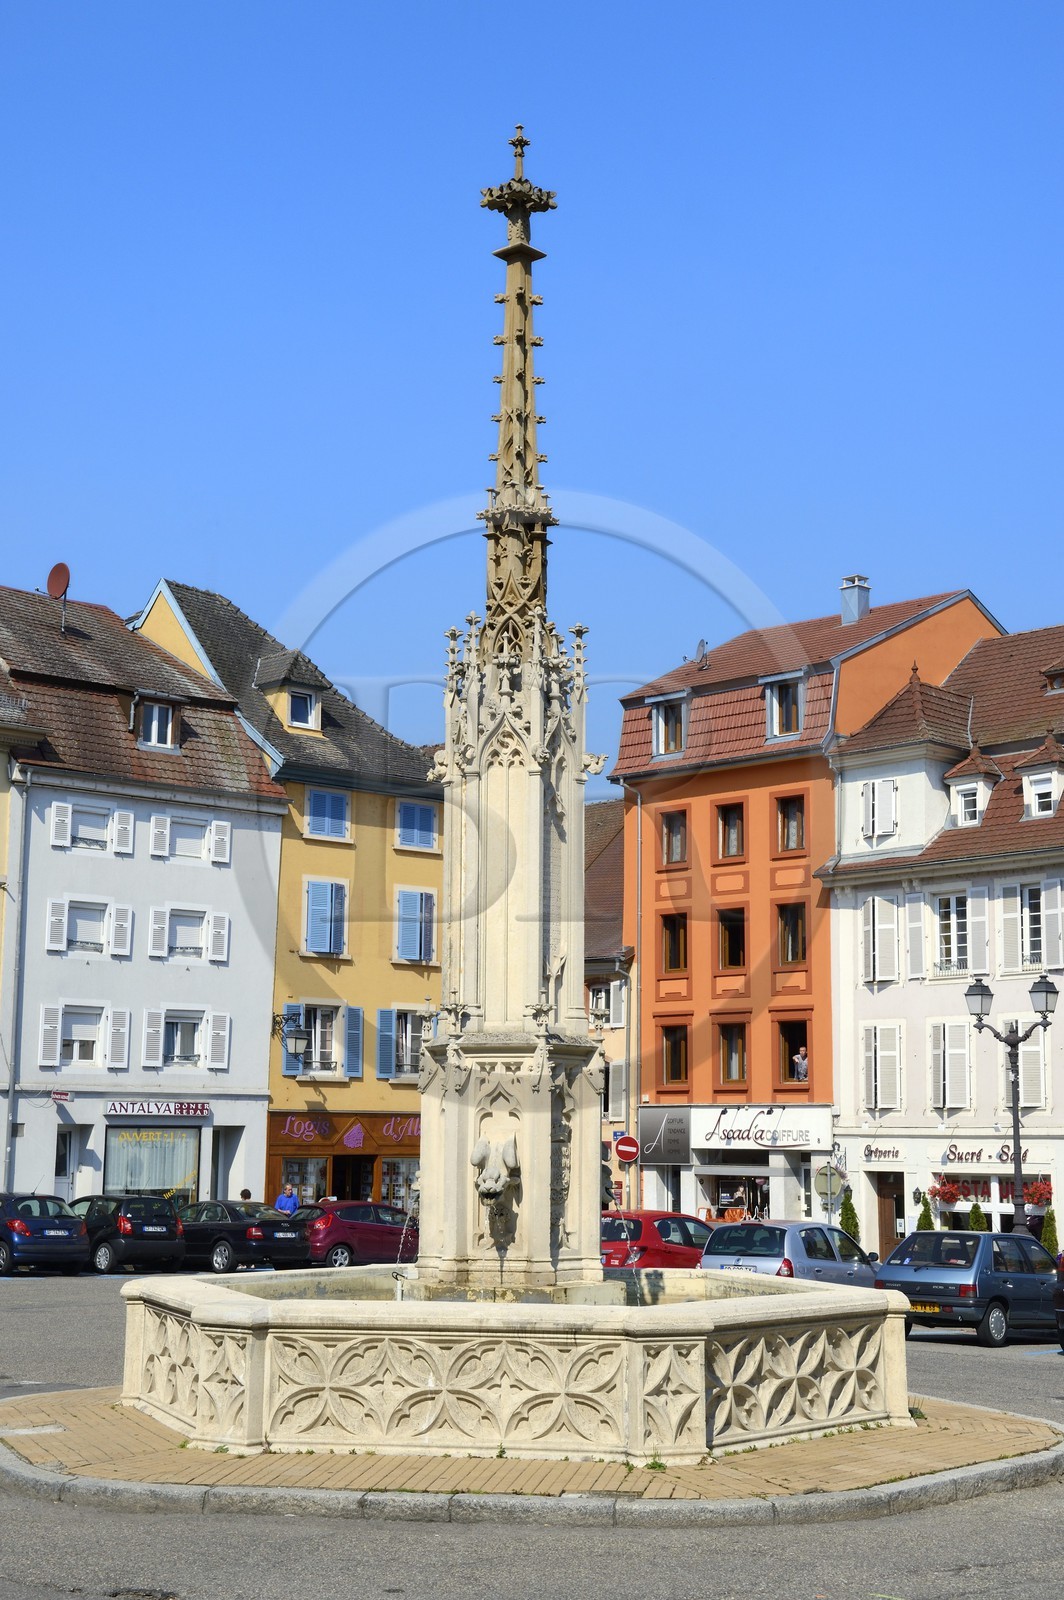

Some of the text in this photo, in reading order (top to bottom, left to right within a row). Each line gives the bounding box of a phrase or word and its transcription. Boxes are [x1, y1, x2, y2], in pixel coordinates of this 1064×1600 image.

[108, 1102, 172, 1114] ANTALYA
[281, 1114, 330, 1142] Logis
[704, 1110, 810, 1145] Ascadia COIFFURE
[118, 1131, 163, 1142] OUVERT
[863, 1144, 899, 1161] Crêperie
[946, 1144, 984, 1162] Sucré
[998, 1144, 1030, 1162] Saé
